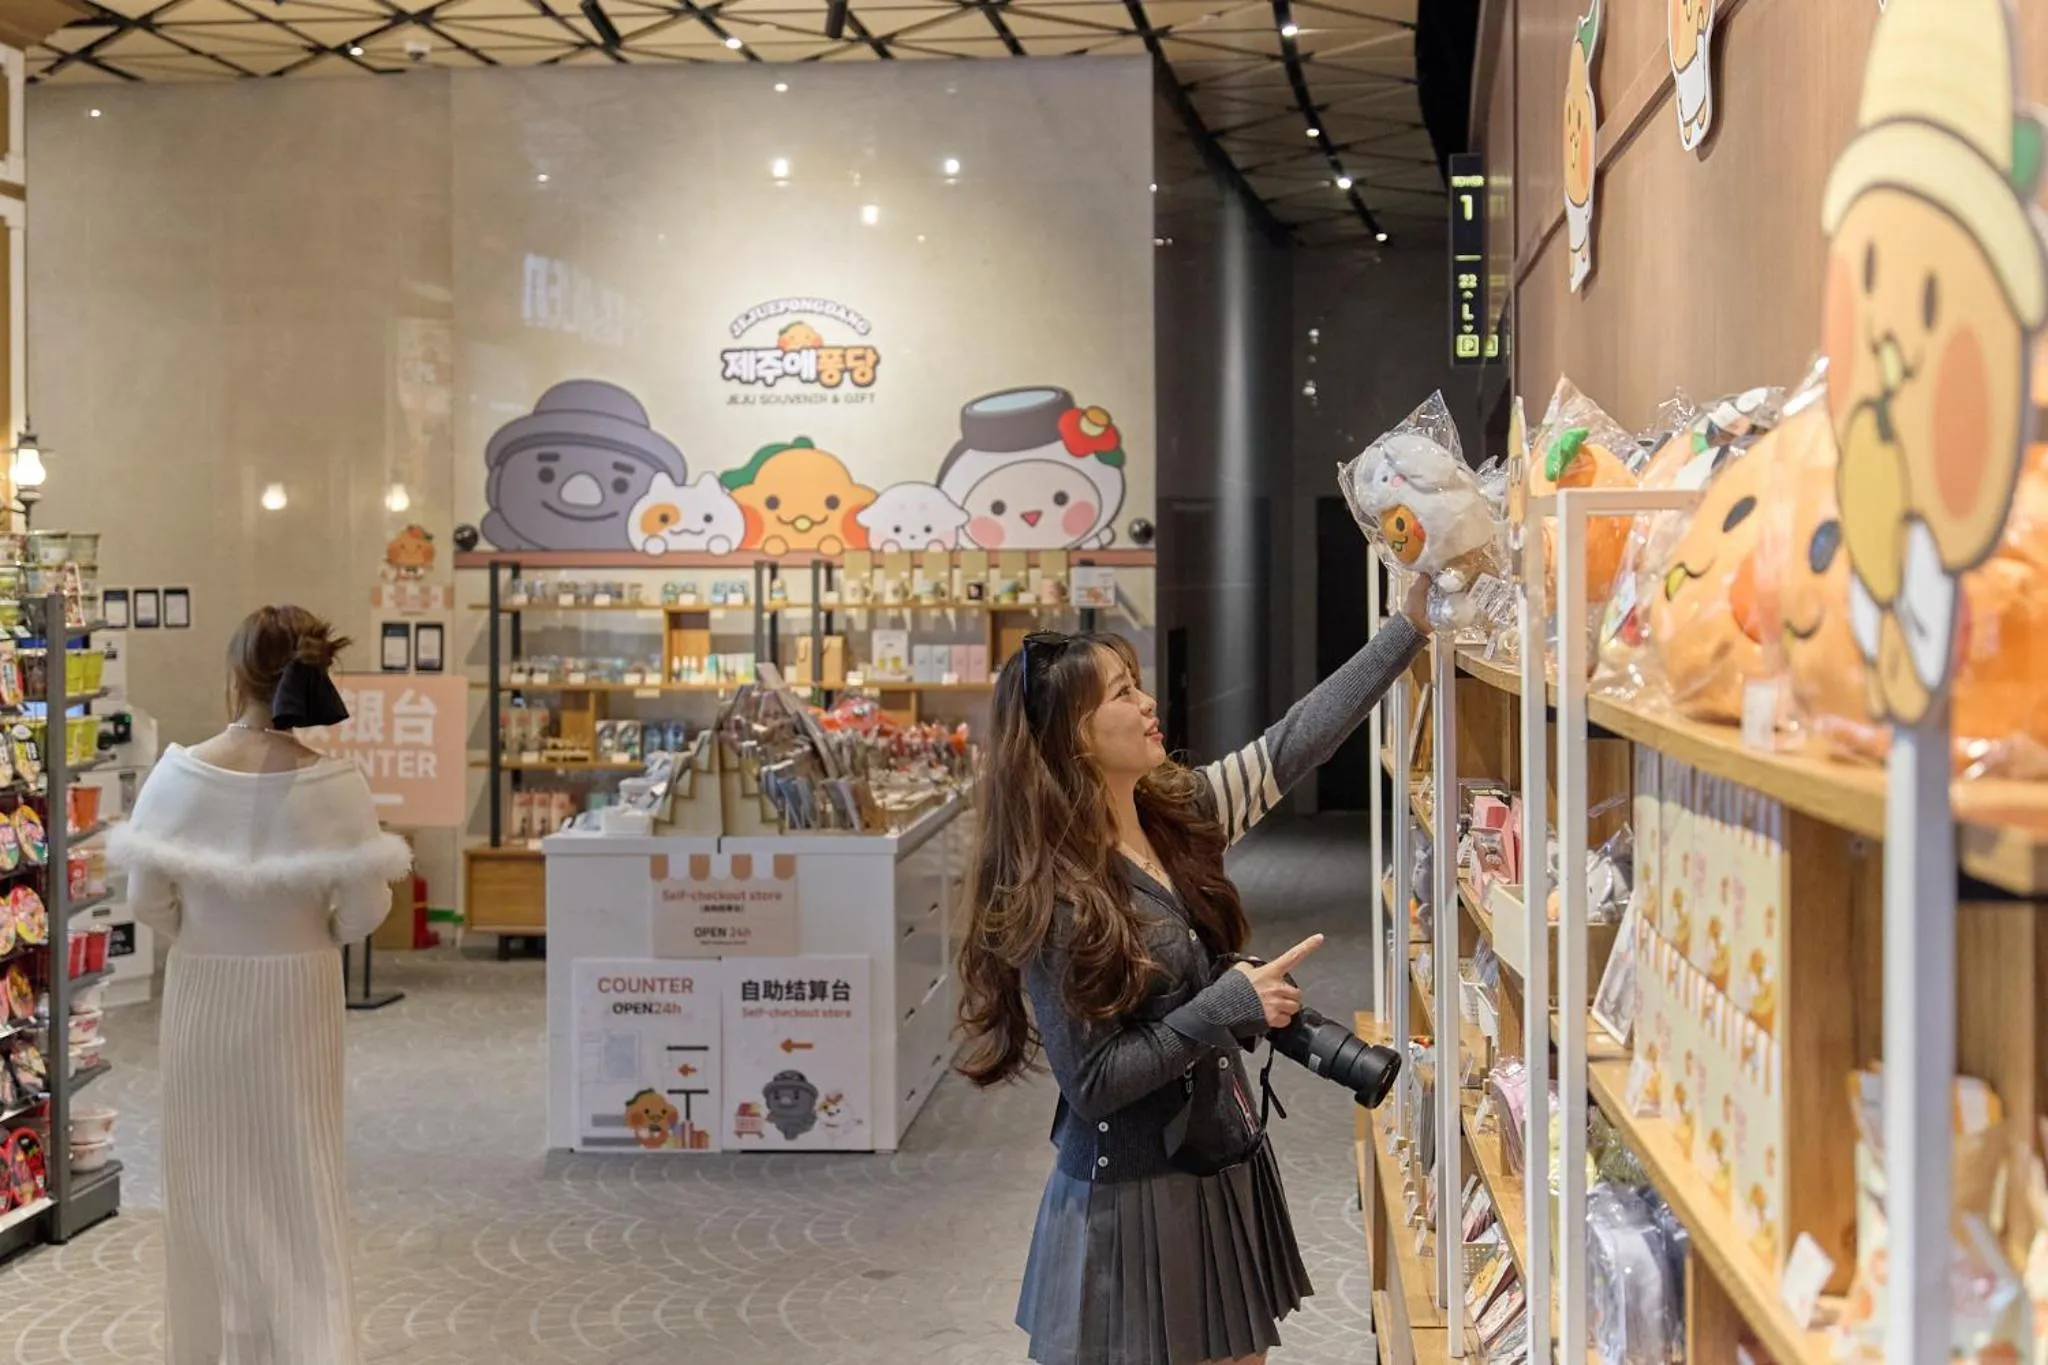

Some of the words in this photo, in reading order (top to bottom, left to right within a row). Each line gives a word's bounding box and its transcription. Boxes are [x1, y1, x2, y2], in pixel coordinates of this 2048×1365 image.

[1460, 195, 1472, 220] 1
[1461, 303, 1474, 321] L
[721, 346, 880, 388] 제주에퐁당
[727, 392, 756, 405] JEJU
[759, 392, 828, 405] SOUVENIR
[831, 393, 841, 404] &
[844, 392, 876, 404] GIFT
[662, 889, 746, 902] Self-checkout
[750, 890, 782, 902] store
[694, 927, 727, 938] OPEN
[597, 976, 694, 994] COUNTER
[741, 979, 851, 1002] 自助结算台
[742, 1006, 819, 1019] Self-checkout
[822, 1008, 852, 1018] store
